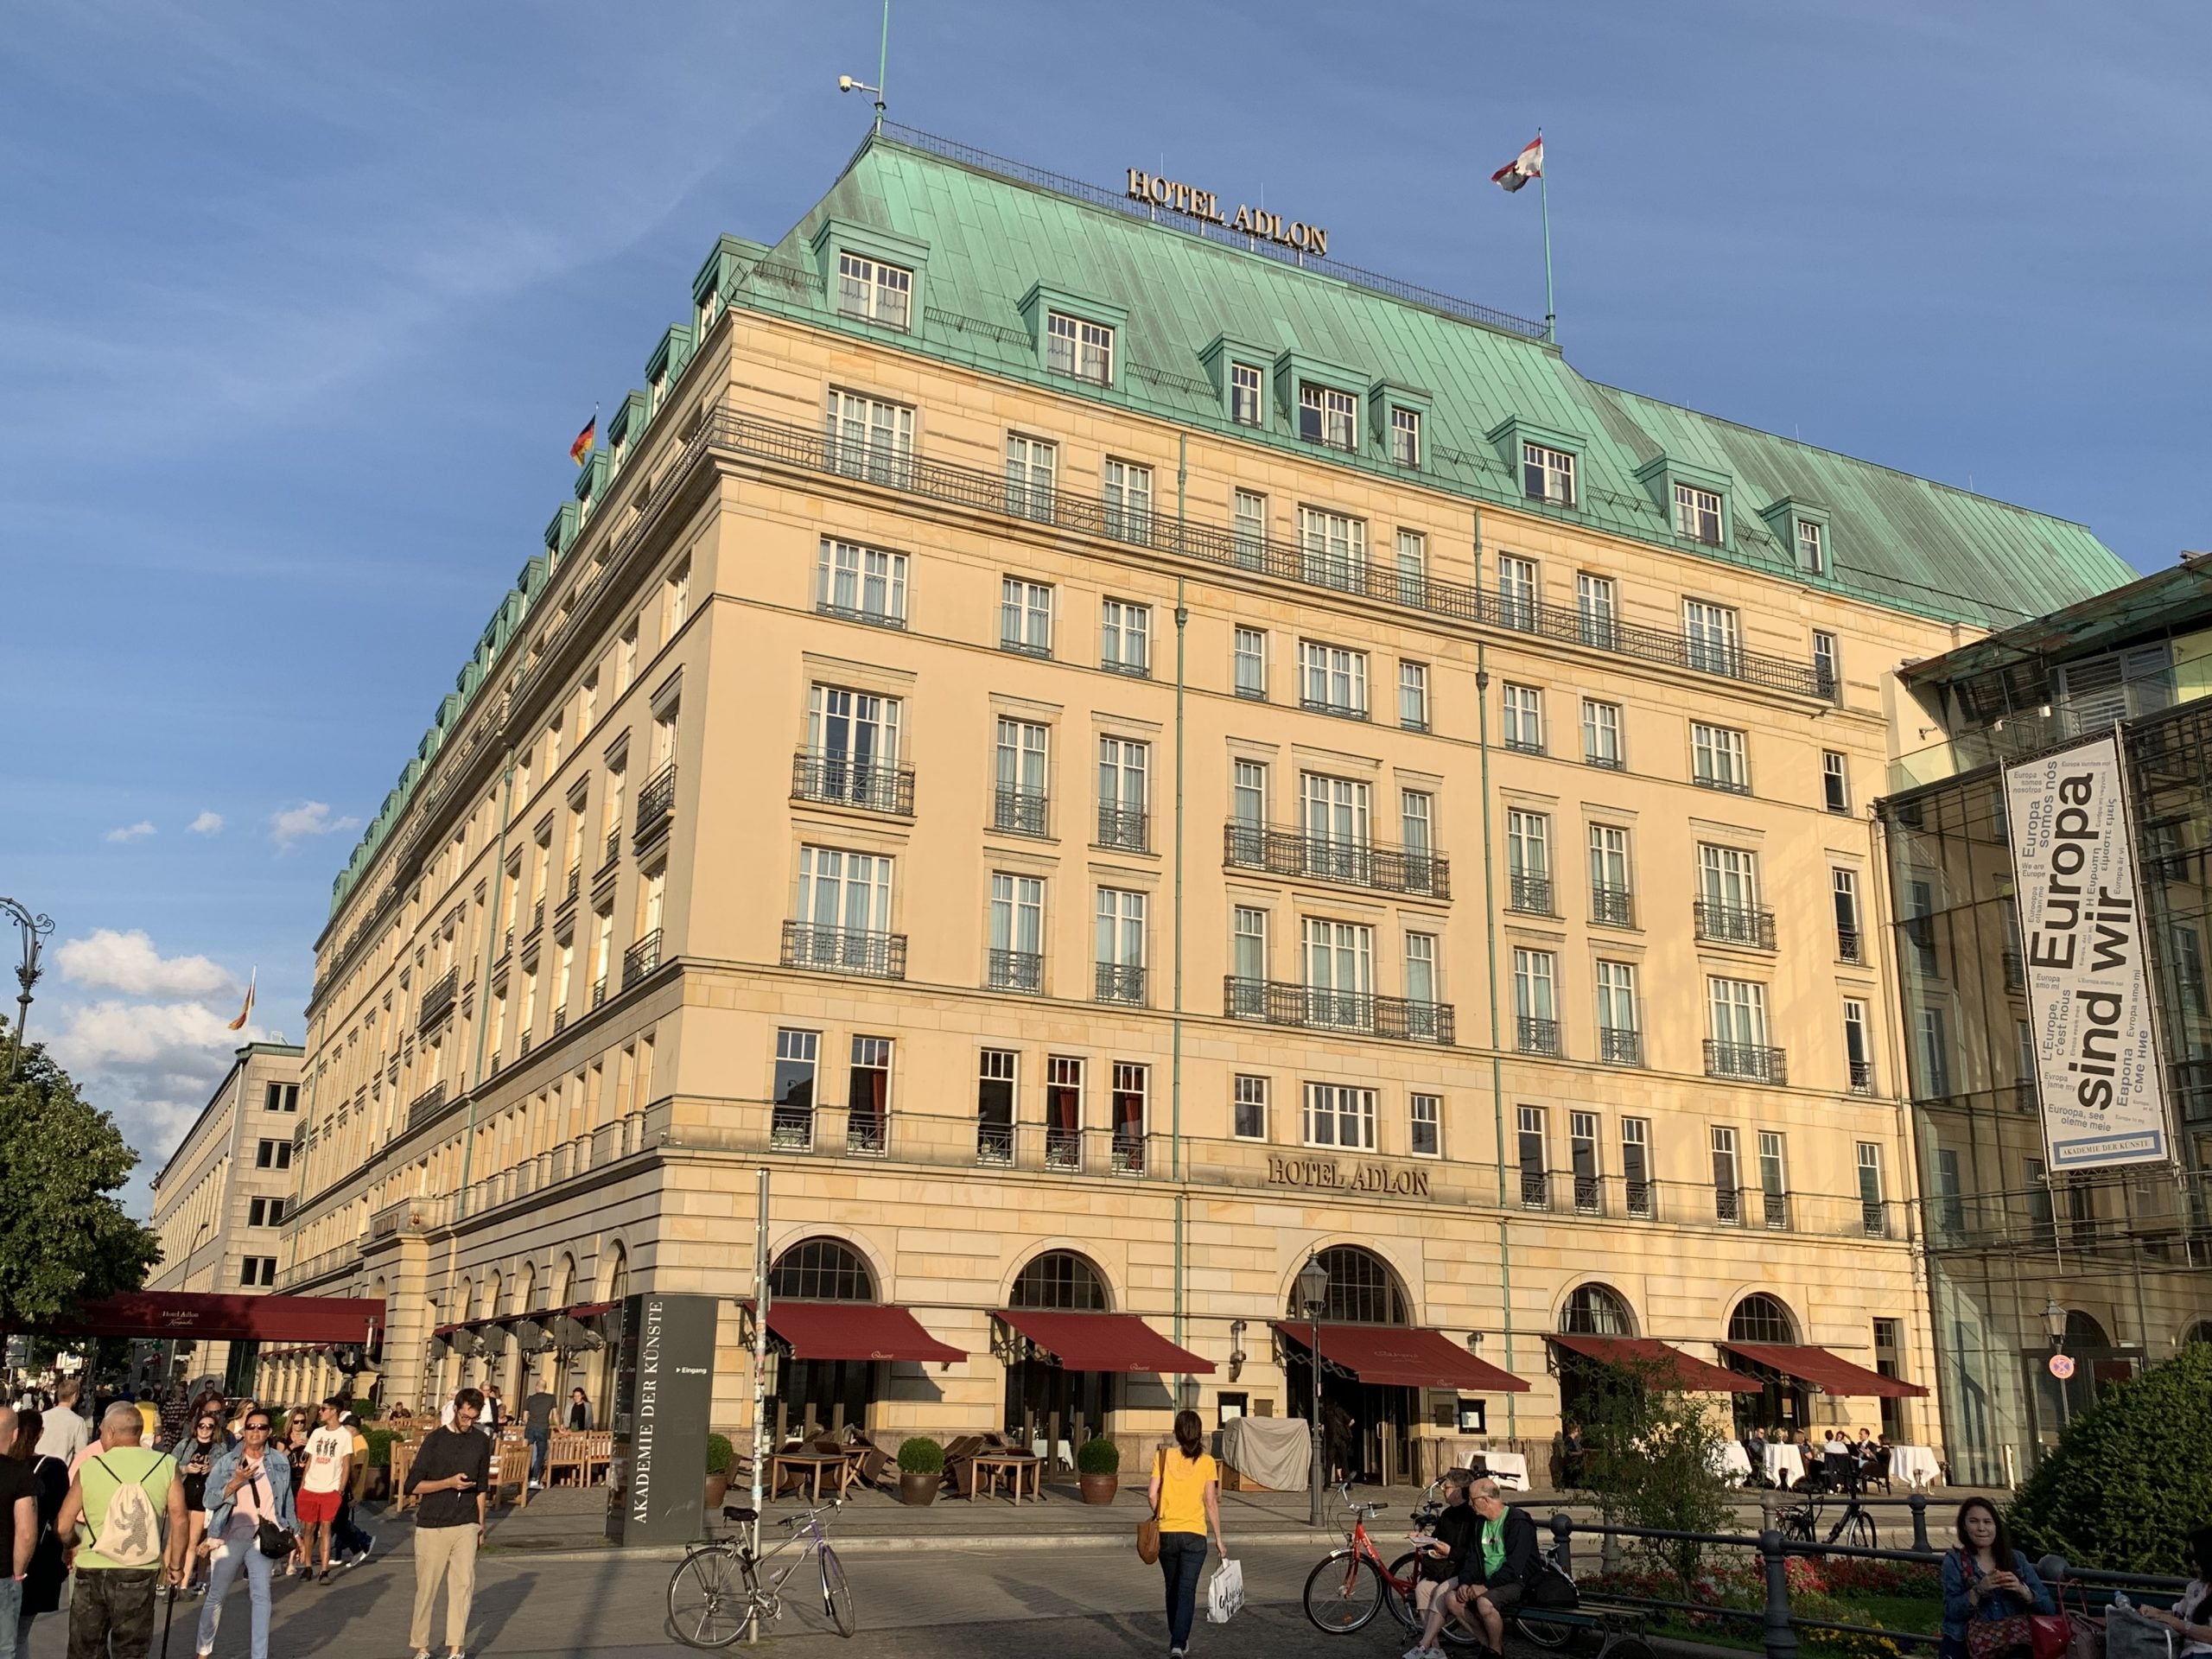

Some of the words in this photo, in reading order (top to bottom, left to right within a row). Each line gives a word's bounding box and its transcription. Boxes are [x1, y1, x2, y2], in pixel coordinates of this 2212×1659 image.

[1126, 167, 1225, 226] HOTEL
[1231, 203, 1327, 257] ADLON
[2044, 760, 2057, 790] nós
[2022, 800, 2041, 857] Europa
[2040, 795, 2054, 848] somos
[2022, 870, 2045, 879] Europe
[2030, 772, 2100, 969] Europa
[2113, 867, 2124, 894] Europa
[2028, 887, 2038, 923] Eurooppa
[2084, 886, 2133, 972] wir
[2036, 973, 2060, 982] Europa
[2060, 989, 2071, 1020] nous
[2126, 1005, 2138, 1037] Evropa
[2133, 969, 2141, 980] mi
[2069, 990, 2122, 1110] sind
[2138, 1030, 2148, 1058] ние
[2044, 1072, 2068, 1082] Evropa
[2117, 1048, 2133, 1107] Европа
[2134, 1064, 2145, 1093] сме
[2048, 1103, 2086, 1119] Euroopa,
[2061, 1116, 2088, 1128] oleme
[2063, 1145, 2100, 1156] AKADEMIE
[2102, 1142, 2117, 1152] DER
[1268, 1157, 1344, 1189] HOTEL
[1351, 1161, 1429, 1196] ADLON
[642, 1301, 663, 1374] KÜNSTE
[641, 1380, 658, 1417] DER
[633, 1424, 653, 1523] AKADEMIE
